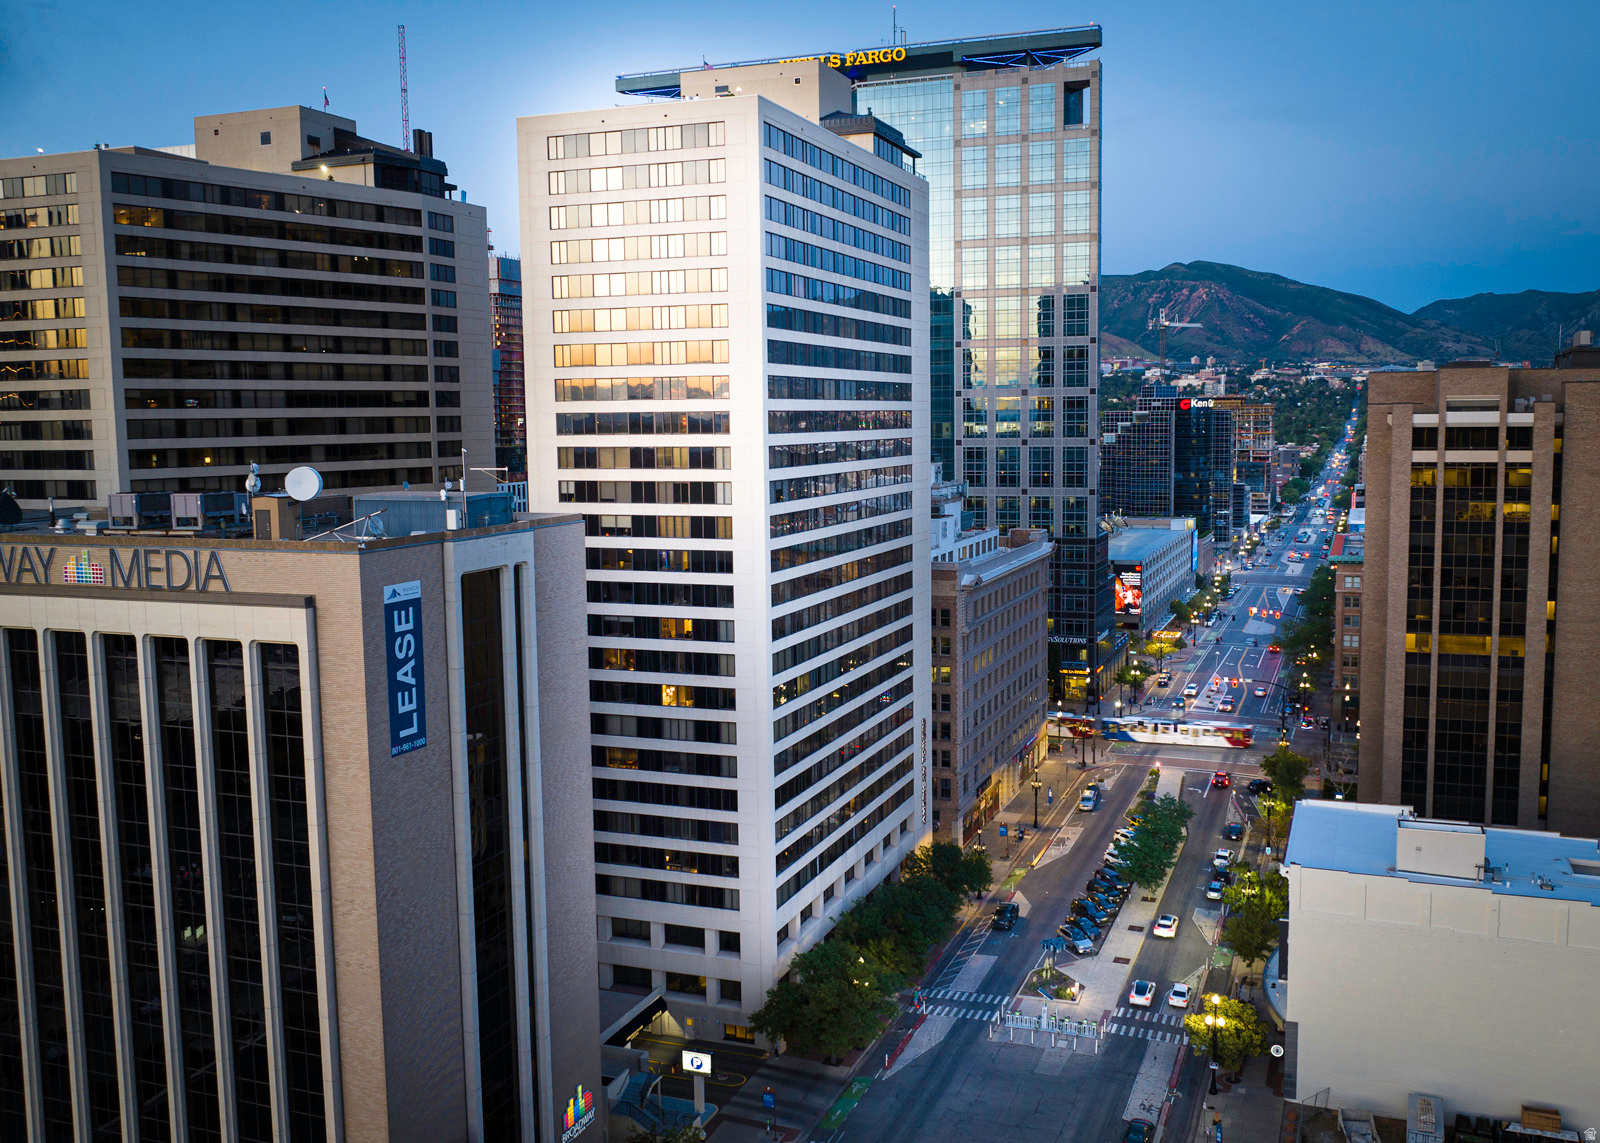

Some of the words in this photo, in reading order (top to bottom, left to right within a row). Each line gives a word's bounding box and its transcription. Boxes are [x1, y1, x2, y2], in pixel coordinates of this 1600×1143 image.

[845, 47, 906, 67] FARGO
[1191, 398, 1207, 408] Ken
[109, 546, 232, 592] MEDIA
[393, 606, 418, 738] LEASE
[562, 1106, 595, 1143] BROADWAY
